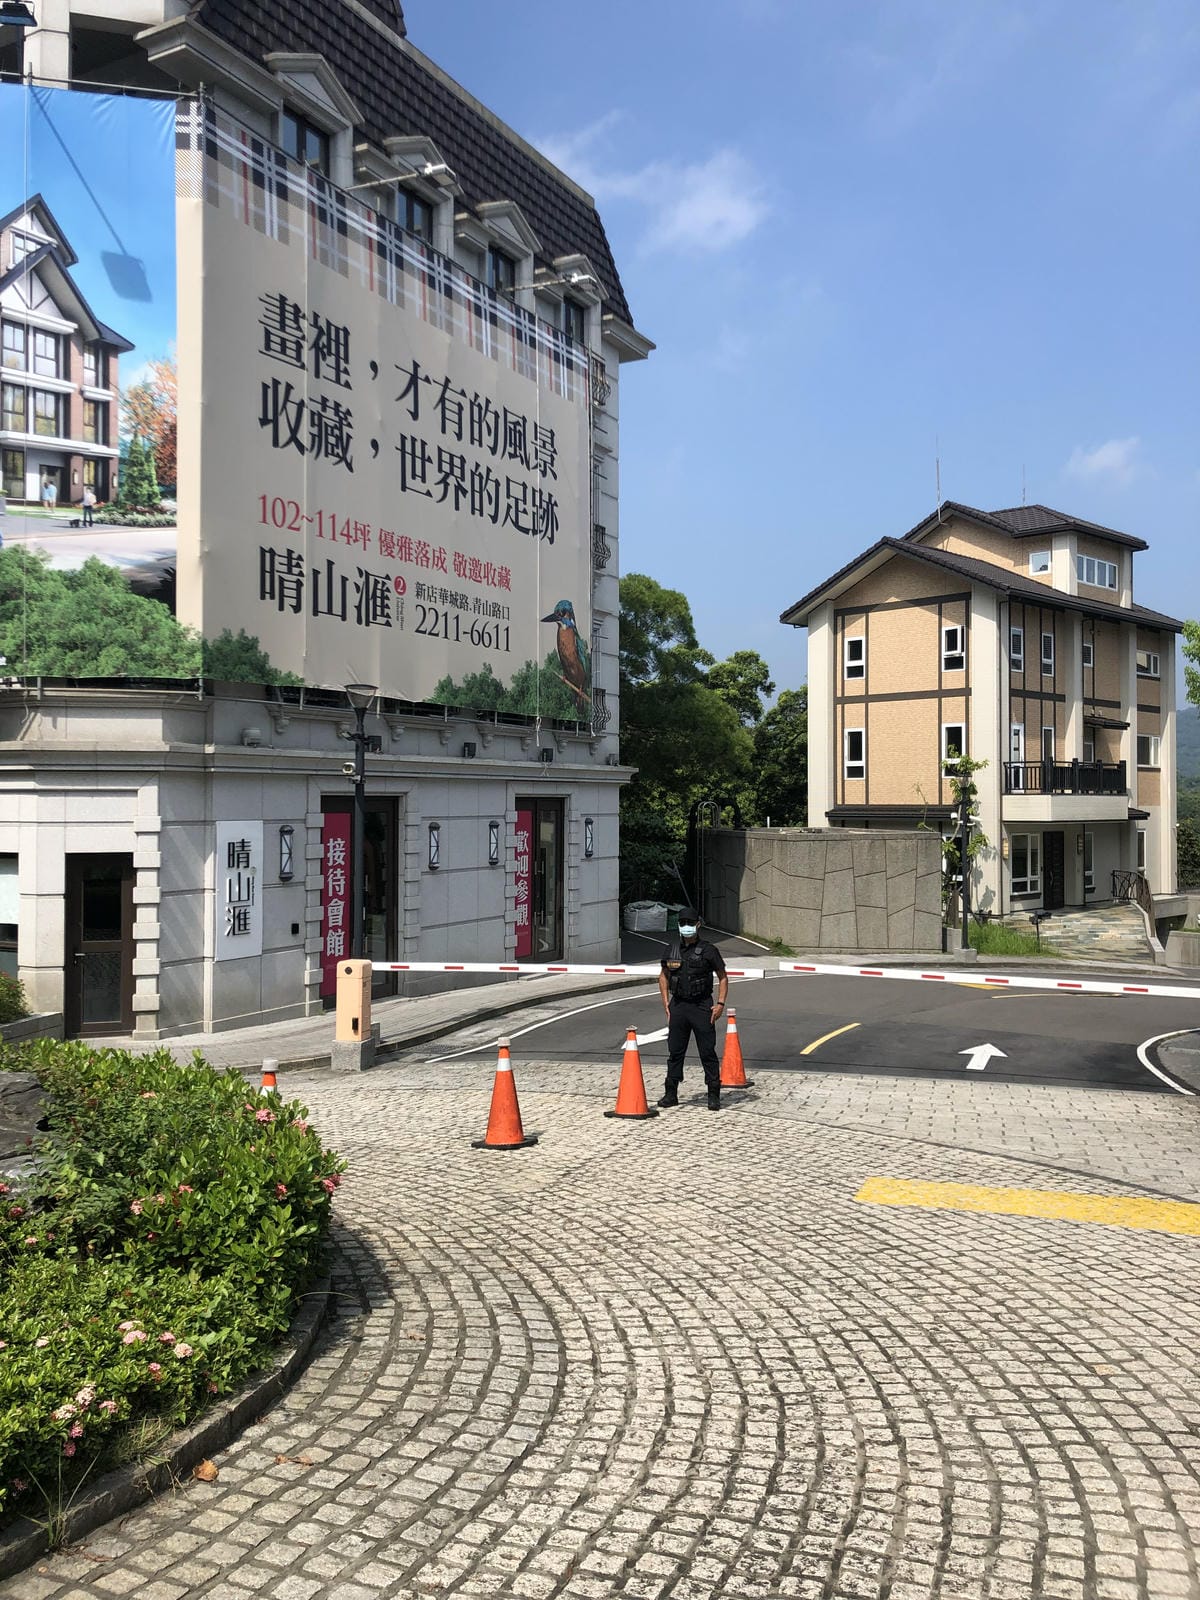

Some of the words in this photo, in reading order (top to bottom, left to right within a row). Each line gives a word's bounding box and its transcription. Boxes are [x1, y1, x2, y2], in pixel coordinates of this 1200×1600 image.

[378, 527, 448, 574] 優雅落成
[452, 551, 512, 592] 敬邀收藏
[414, 603, 511, 652] 2211-6611
[326, 837, 346, 957] 接待會館
[516, 830, 529, 926] 歡迎參觀
